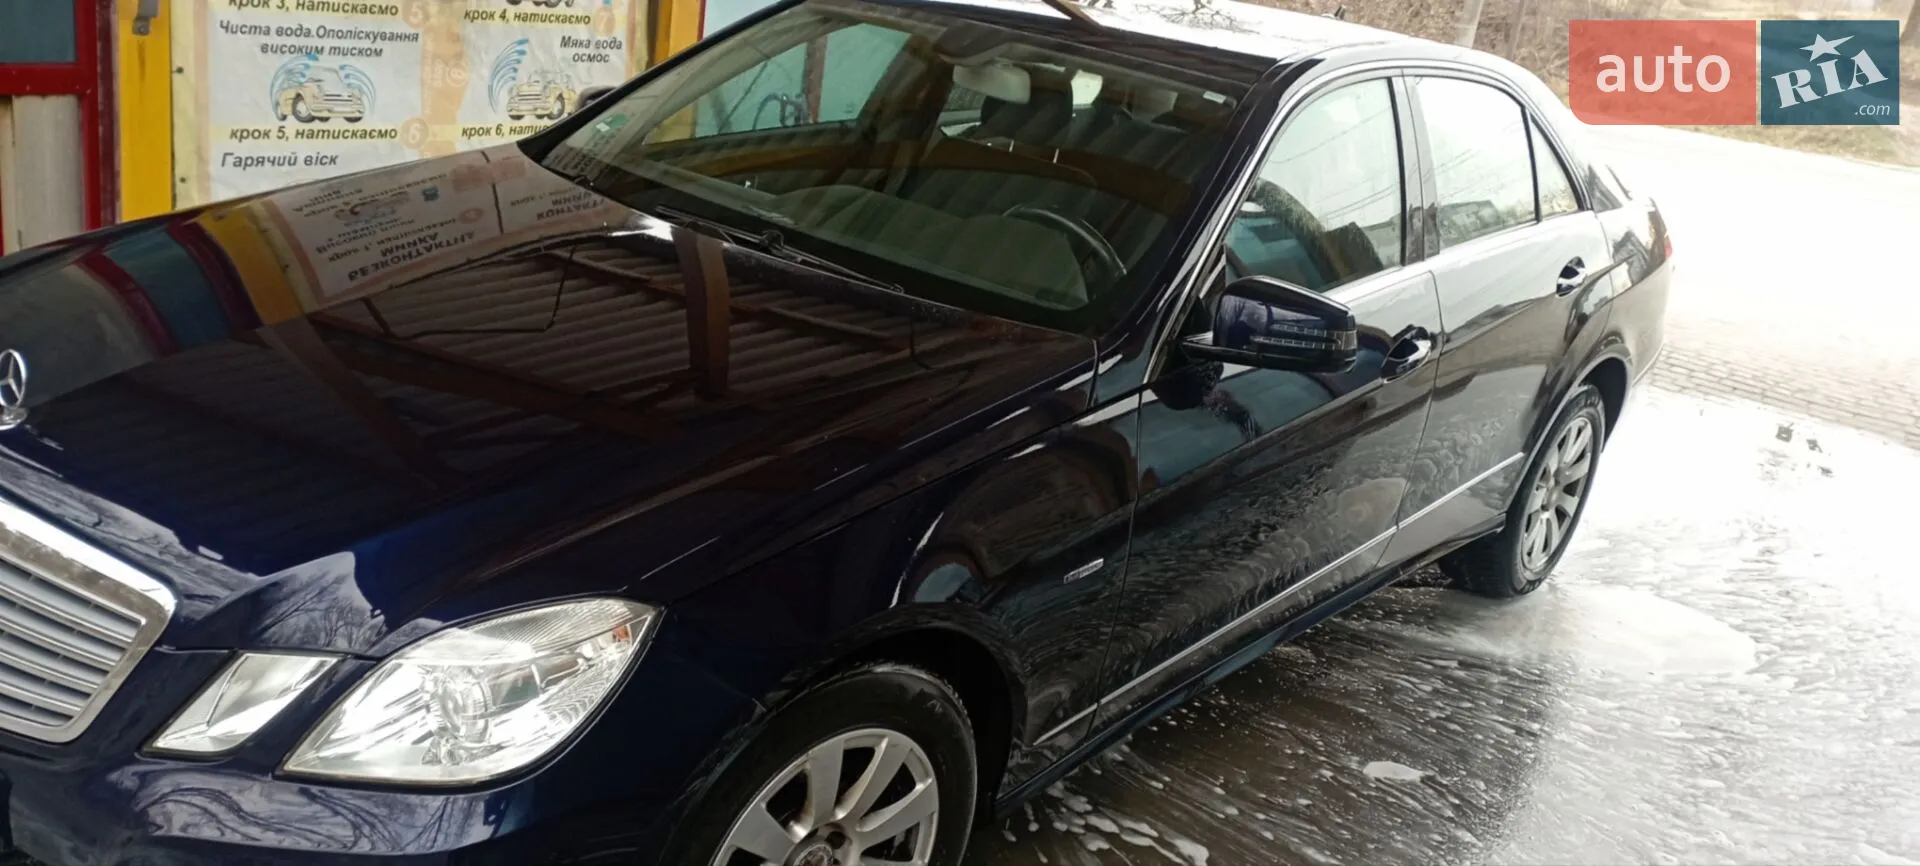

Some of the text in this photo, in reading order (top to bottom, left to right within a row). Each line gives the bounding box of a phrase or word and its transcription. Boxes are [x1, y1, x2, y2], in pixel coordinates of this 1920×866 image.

[295, 0, 399, 16] натискаємо
[463, 8, 591, 25] крок 4, натискаємо
[219, 20, 271, 37] Чиста
[260, 43, 384, 58] високим тиском
[560, 36, 623, 50] Мяка вода
[572, 52, 610, 63] осмос
[229, 125, 398, 144] крок 5, натискаємо
[408, 123, 420, 144] 6
[461, 126, 492, 140] крок
[495, 124, 505, 137] 6,
[221, 152, 339, 170] Гарячий віск
